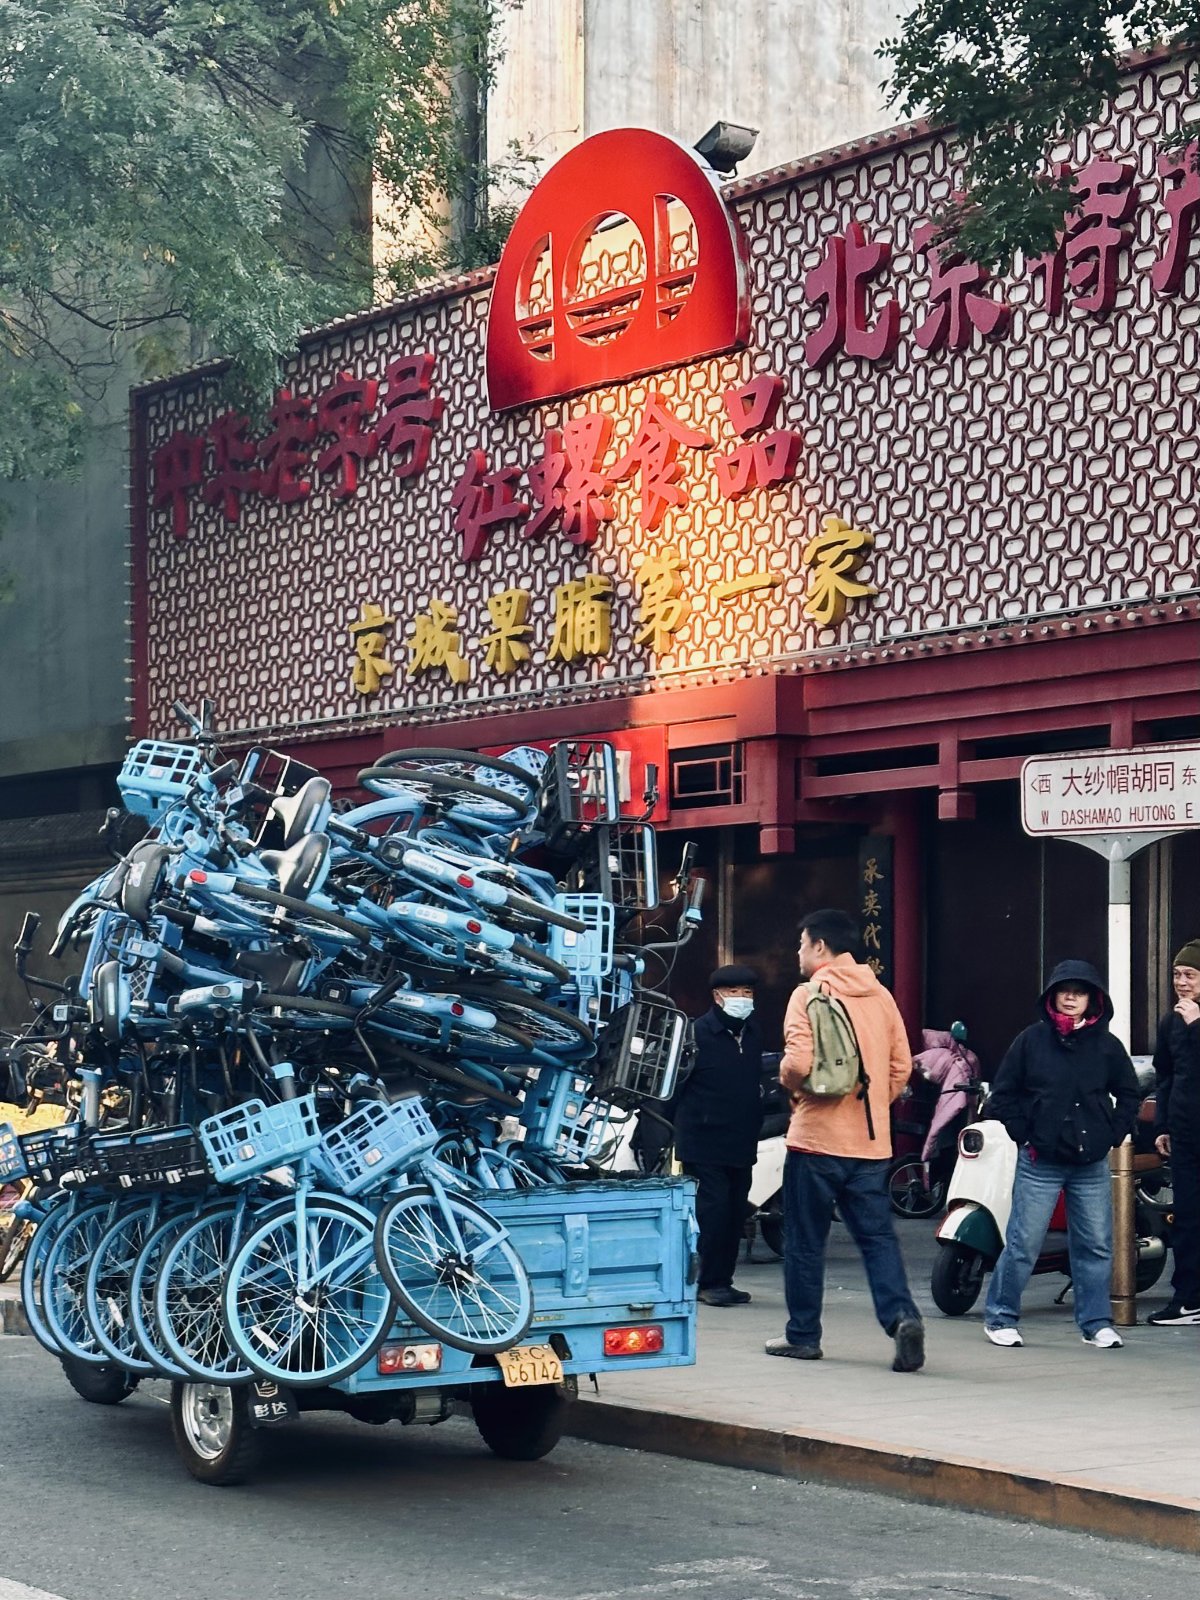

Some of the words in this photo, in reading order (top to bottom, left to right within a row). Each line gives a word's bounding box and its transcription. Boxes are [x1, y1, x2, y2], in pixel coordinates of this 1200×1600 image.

[153, 351, 443, 541] 中华老字号
[450, 374, 803, 562] 红螺食品
[346, 517, 878, 696] 京城果脯第一家
[1038, 773, 1052, 795] 西
[1061, 761, 1175, 797] 大纱帽胡同
[1181, 764, 1197, 786] 东
[1041, 810, 1049, 825] W
[1061, 807, 1122, 826] DASHAMAO
[1129, 804, 1175, 822] HUTONG
[1185, 802, 1193, 819] E
[506, 1361, 561, 1383] C6742
[253, 1401, 289, 1418] 彭达
